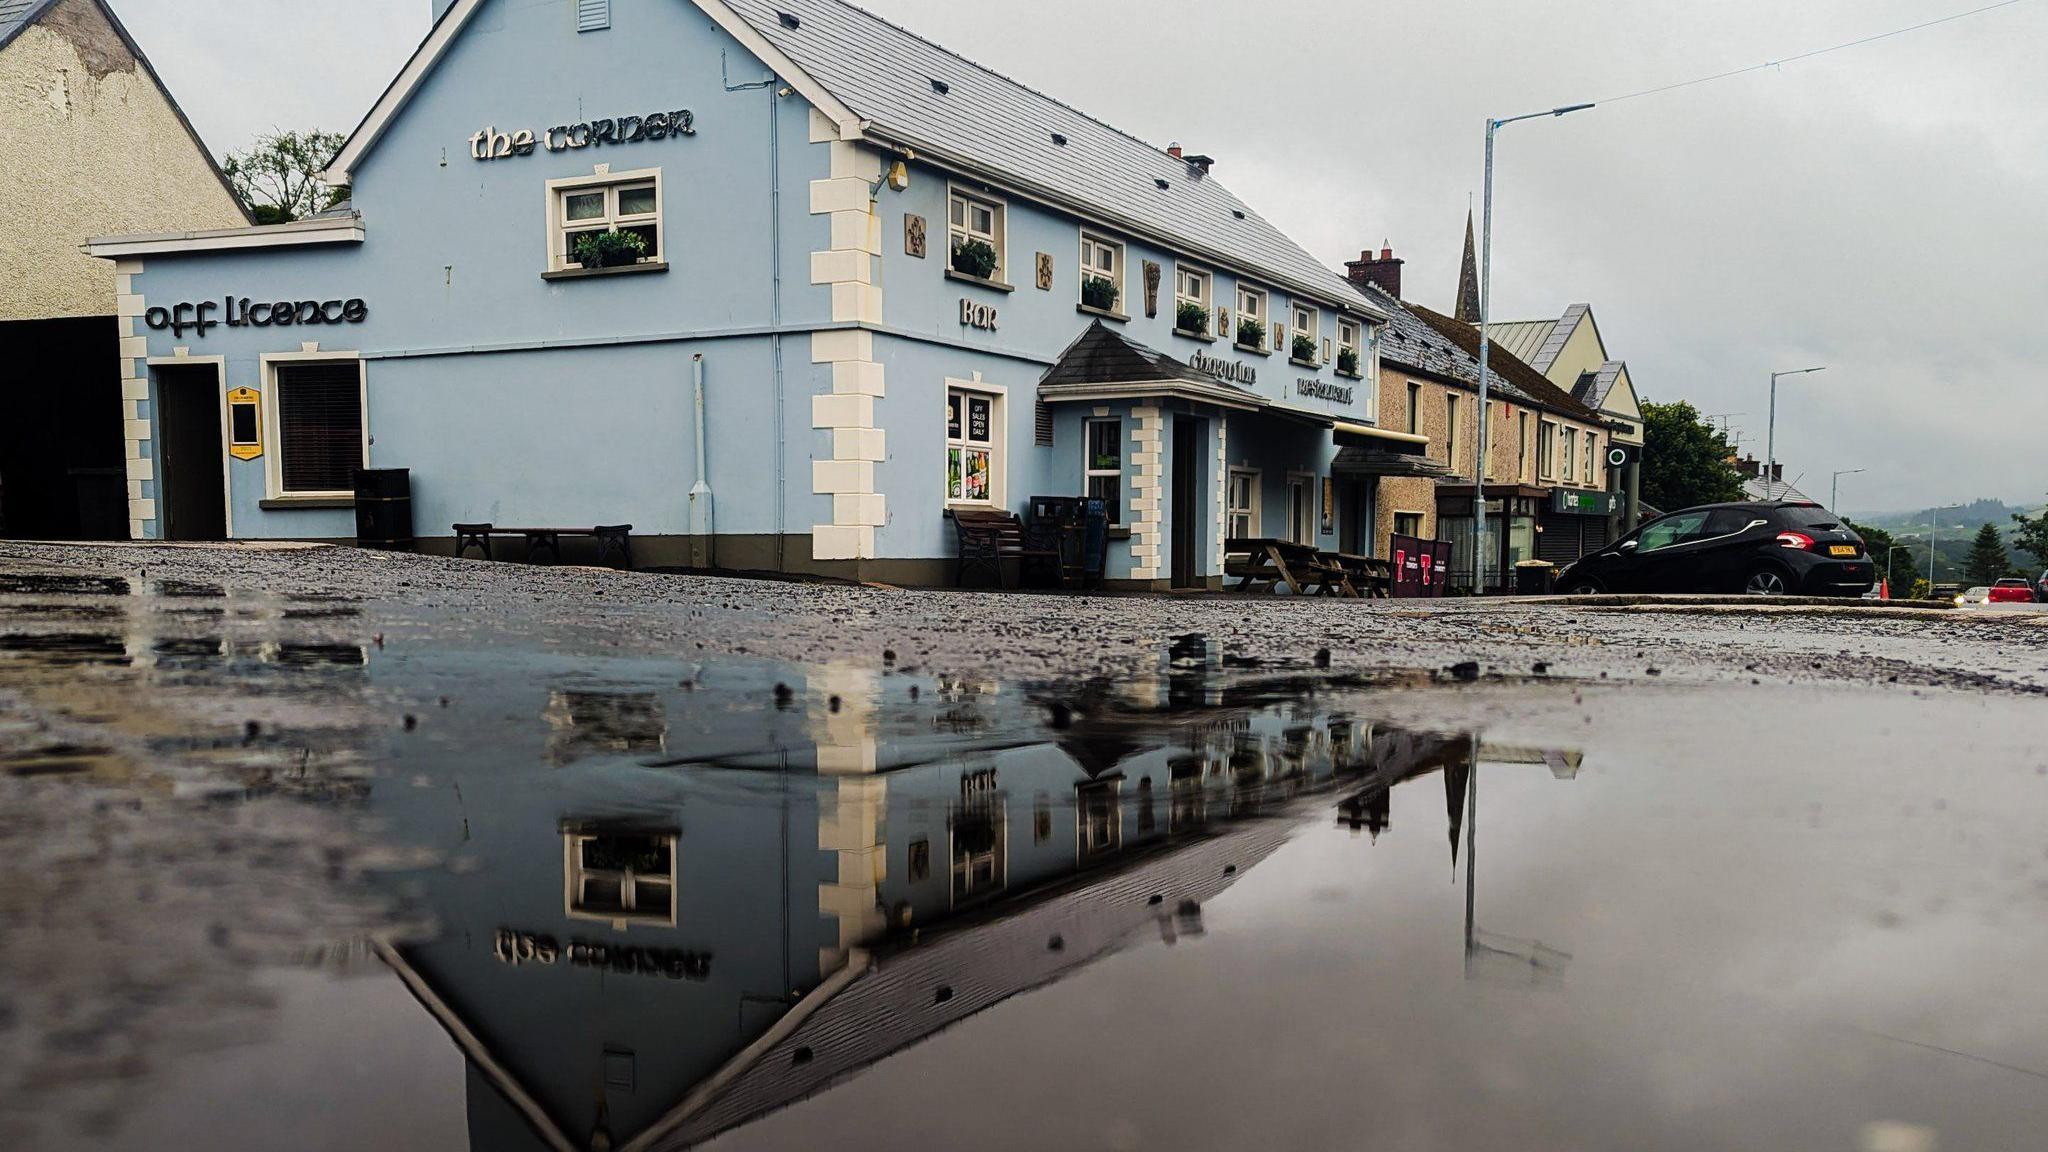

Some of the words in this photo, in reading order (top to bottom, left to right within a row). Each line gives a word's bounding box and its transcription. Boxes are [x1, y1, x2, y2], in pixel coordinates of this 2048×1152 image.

[468, 126, 536, 161] the
[145, 301, 217, 339] off
[225, 296, 369, 328] licence
[960, 298, 998, 332] BAR
